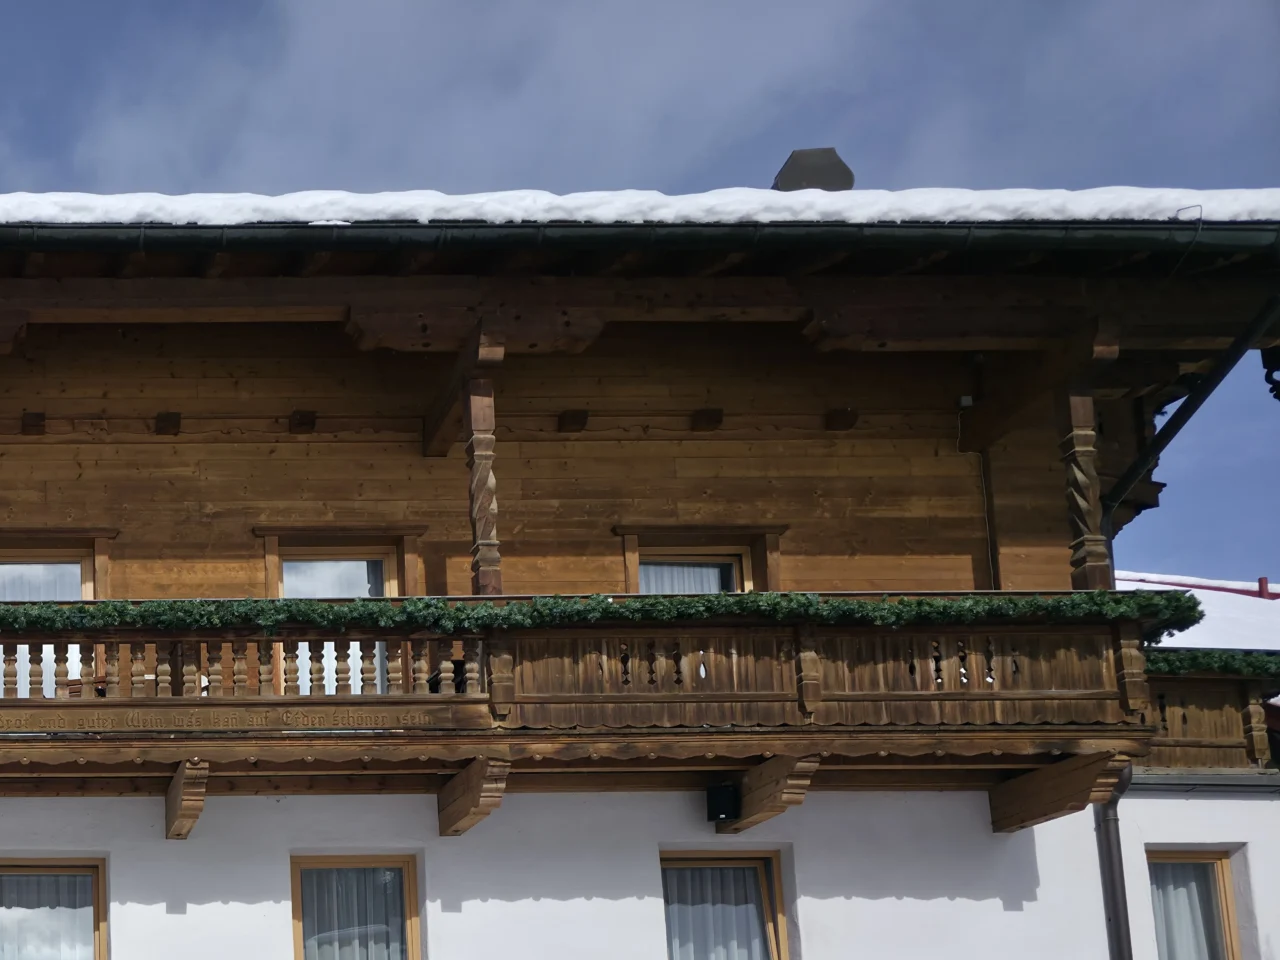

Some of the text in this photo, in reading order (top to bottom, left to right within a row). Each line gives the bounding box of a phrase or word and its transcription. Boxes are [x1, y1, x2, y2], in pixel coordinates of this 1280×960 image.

[39, 713, 66, 729] und
[77, 712, 117, 729] guter
[246, 711, 270, 727] auf
[281, 709, 326, 726] Erden
[332, 708, 388, 727] schöner
